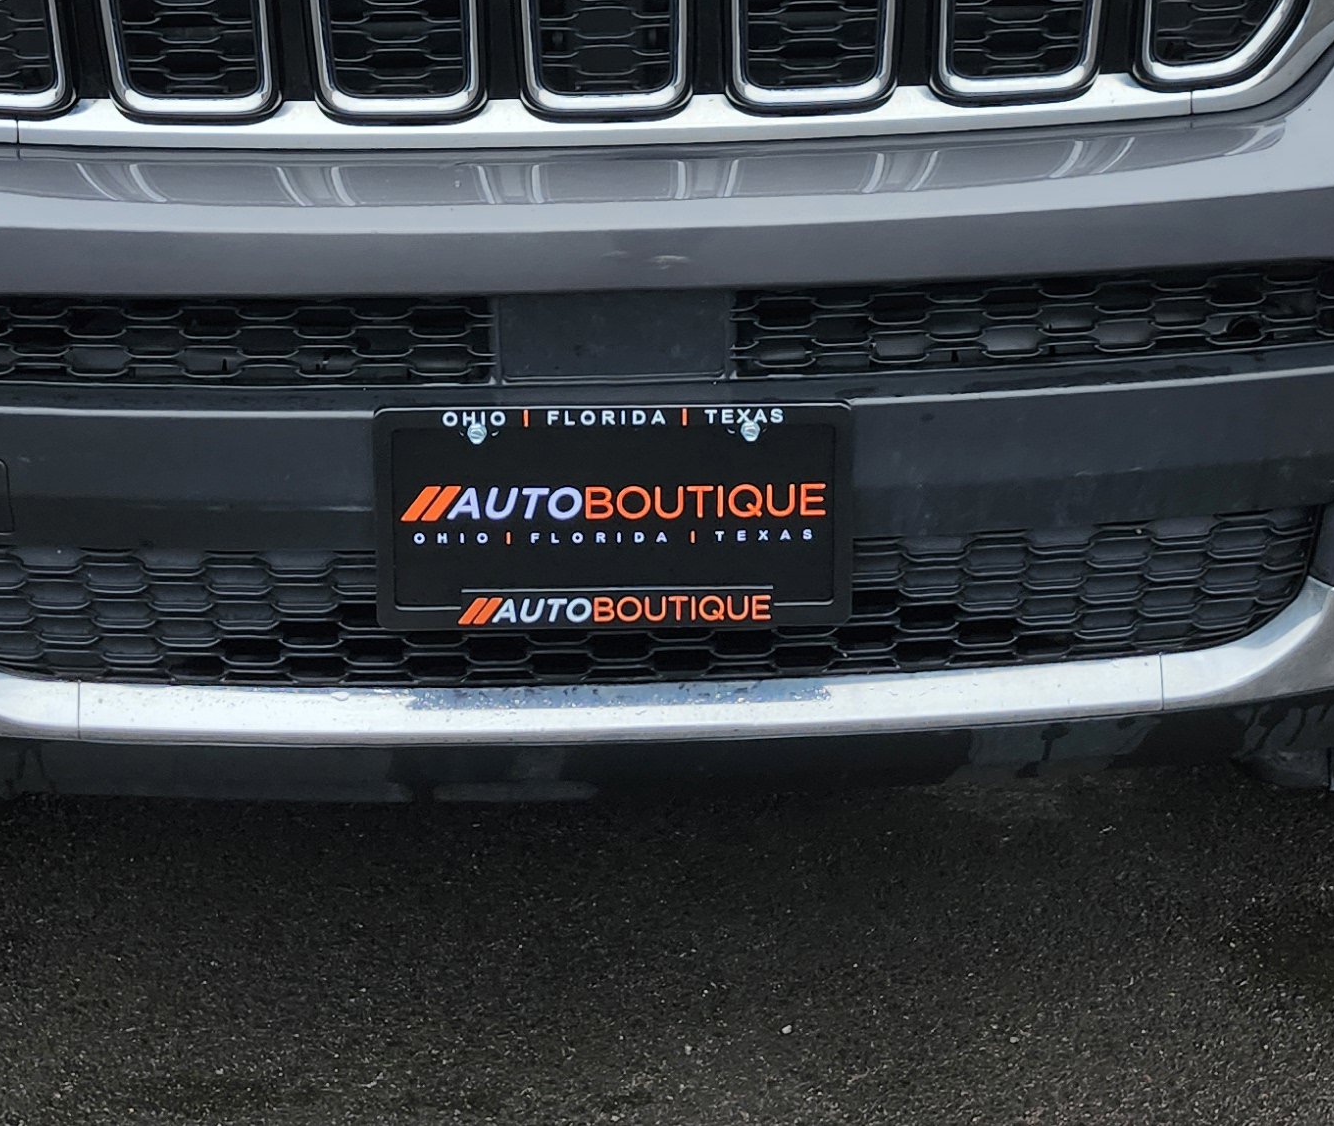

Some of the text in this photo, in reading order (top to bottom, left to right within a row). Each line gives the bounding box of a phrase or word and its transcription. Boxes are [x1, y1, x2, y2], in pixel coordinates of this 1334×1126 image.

[442, 408, 784, 427] OHIO FLORIDA TEXAS
[448, 483, 827, 521] AUTOBOUTIQUE
[413, 529, 813, 545] OHIO FLORIDA TEXAS
[492, 595, 772, 624] AUTOBOUTIQUE
